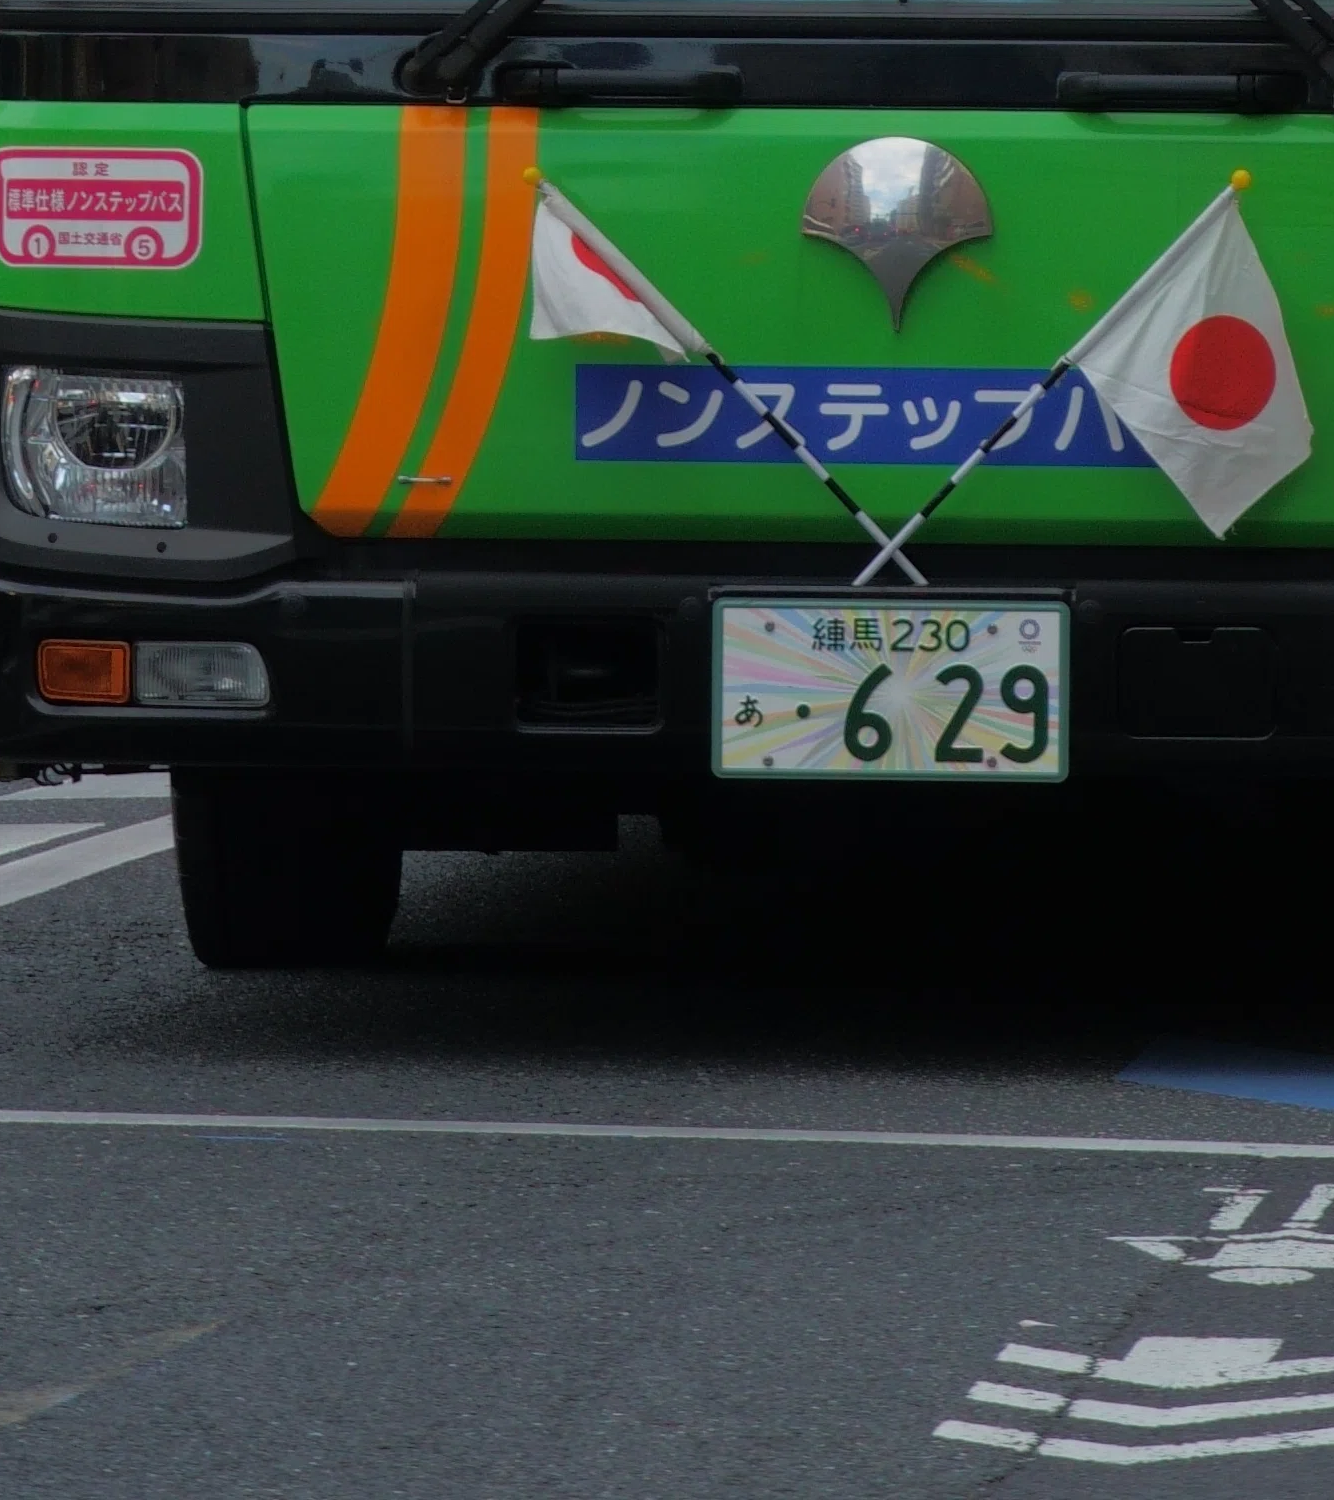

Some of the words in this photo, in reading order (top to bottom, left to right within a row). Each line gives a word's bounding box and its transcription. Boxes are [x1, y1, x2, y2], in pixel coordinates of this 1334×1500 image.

[71, 161, 110, 177] 認定
[8, 187, 183, 213] 標準仕様ノンステップバス
[58, 231, 124, 246] 国土交通省
